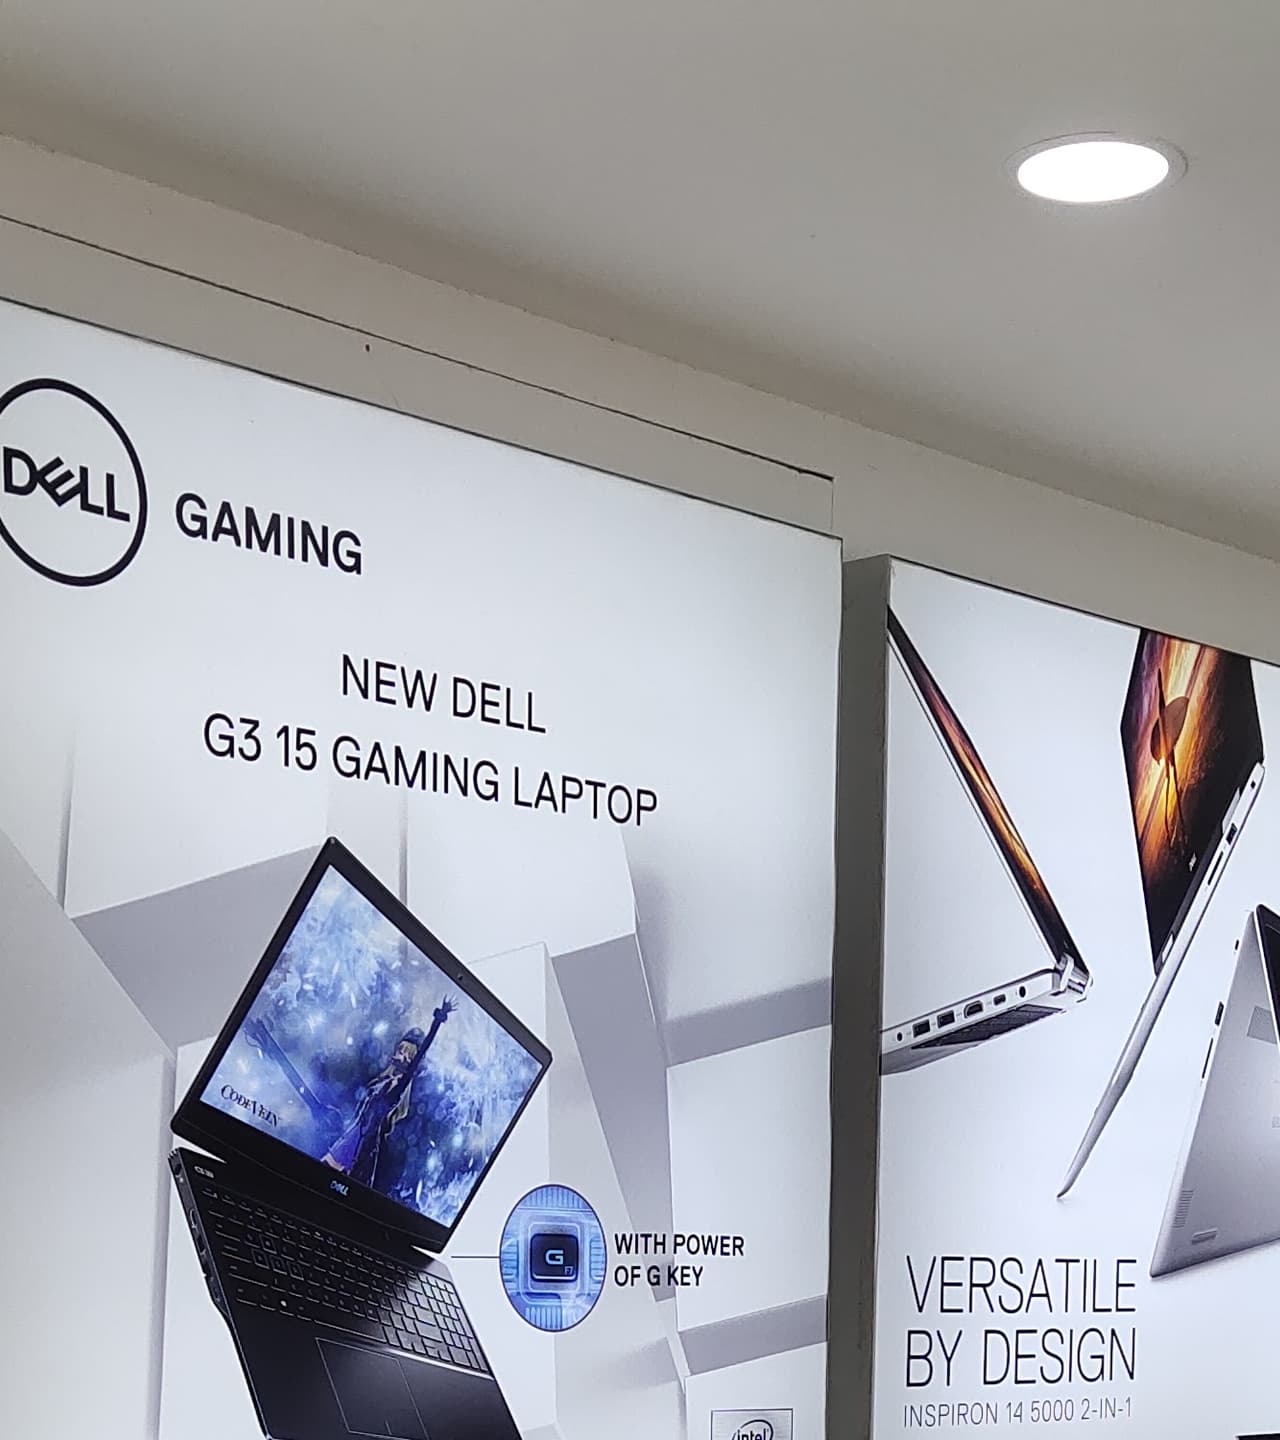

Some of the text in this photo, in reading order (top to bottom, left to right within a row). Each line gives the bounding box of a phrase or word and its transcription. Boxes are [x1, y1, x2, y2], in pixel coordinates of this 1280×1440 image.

[3, 447, 130, 522] DELL
[176, 492, 364, 575] GAMING
[341, 652, 546, 734] NEW DELL
[203, 713, 658, 828] G3 15 GAMING LAPTOP
[545, 1249, 564, 1265] G
[614, 1233, 744, 1256] WITH POWER
[614, 1265, 704, 1286] OF G KEY
[906, 1255, 1137, 1314] VERSATILE
[906, 1327, 1136, 1388] BY DESIGN
[904, 1398, 1132, 1429] INSPIRON 14 5000 2-IN-1
